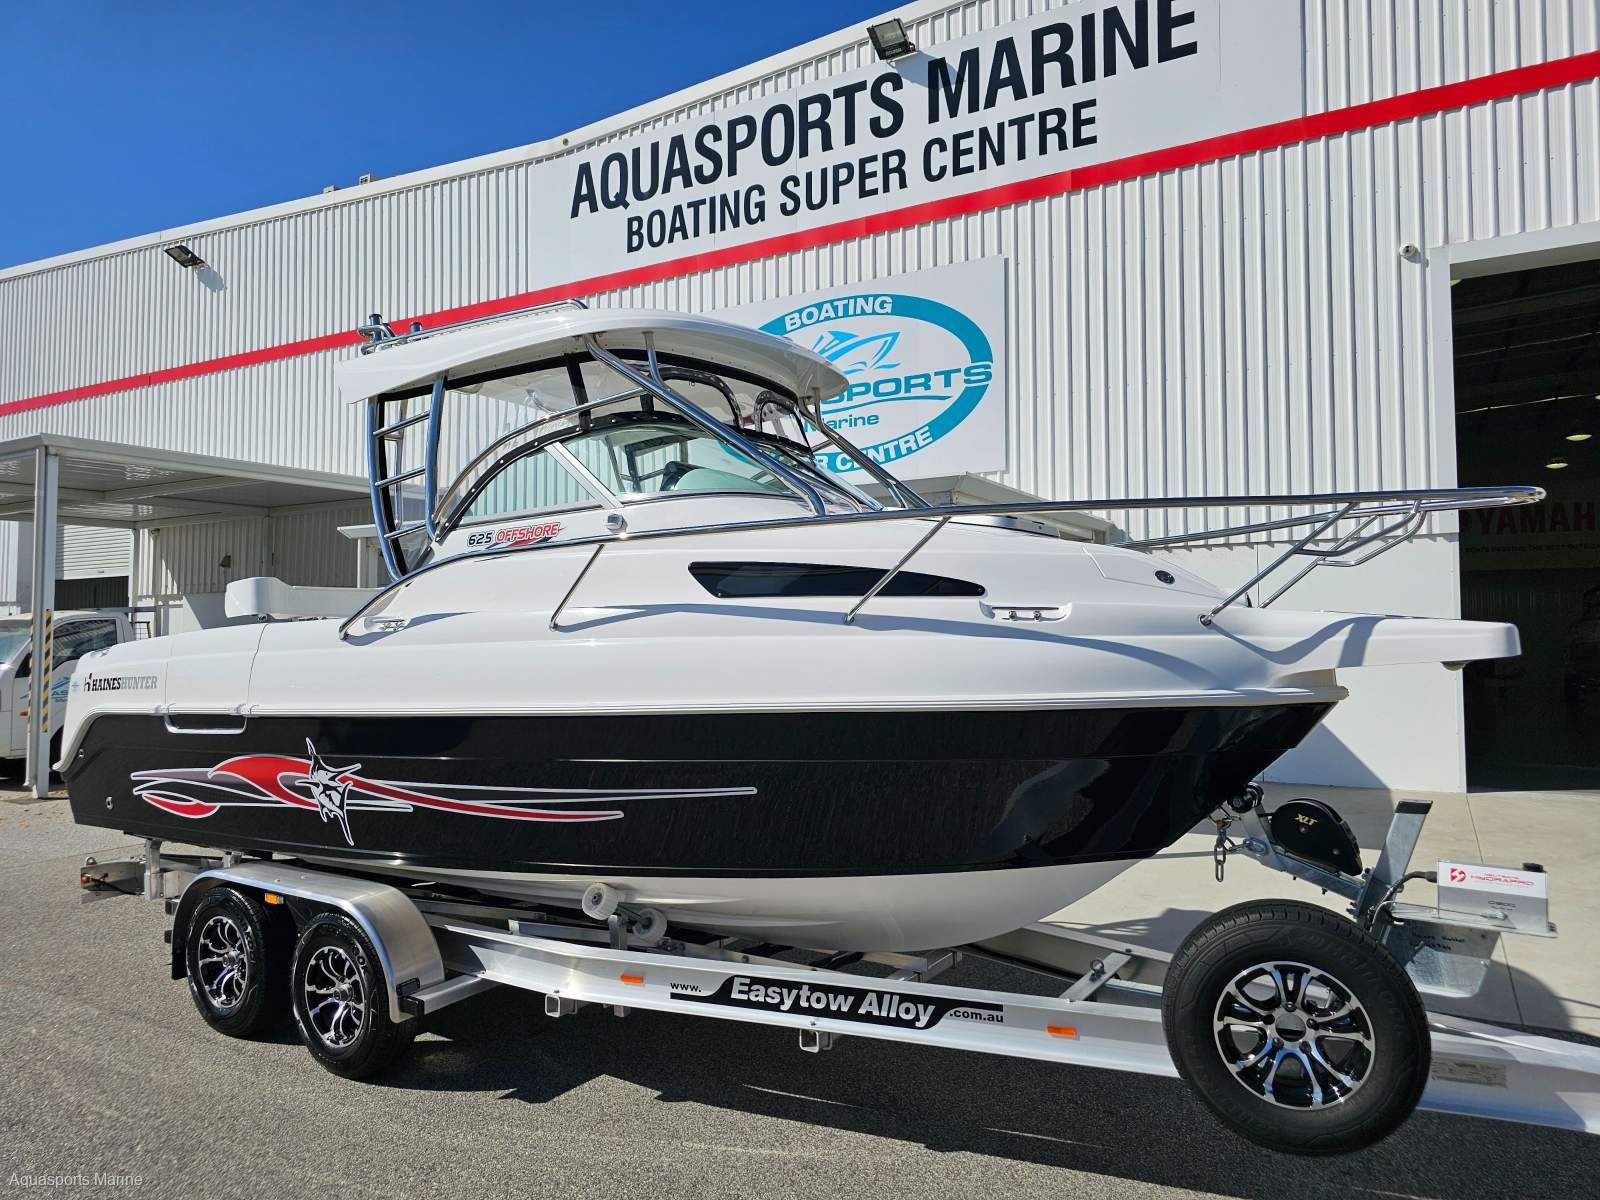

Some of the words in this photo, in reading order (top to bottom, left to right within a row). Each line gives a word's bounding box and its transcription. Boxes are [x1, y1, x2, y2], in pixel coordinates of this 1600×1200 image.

[570, 72, 903, 218] AQUASPORTS
[927, 0, 1198, 125] MARINE
[626, 184, 766, 254] BOATING
[779, 147, 907, 217] SUPER
[921, 98, 1098, 183] CENTRE
[785, 296, 893, 332] BOATING
[836, 426, 933, 471] CNTRE
[468, 531, 493, 546] 625
[496, 522, 561, 543] OFFSHORE
[1295, 813, 1318, 826] XLT
[670, 982, 701, 992] www.
[731, 977, 853, 1012] Easytow
[858, 991, 935, 1027] Alloy
[949, 1009, 1003, 1022] .com.au
